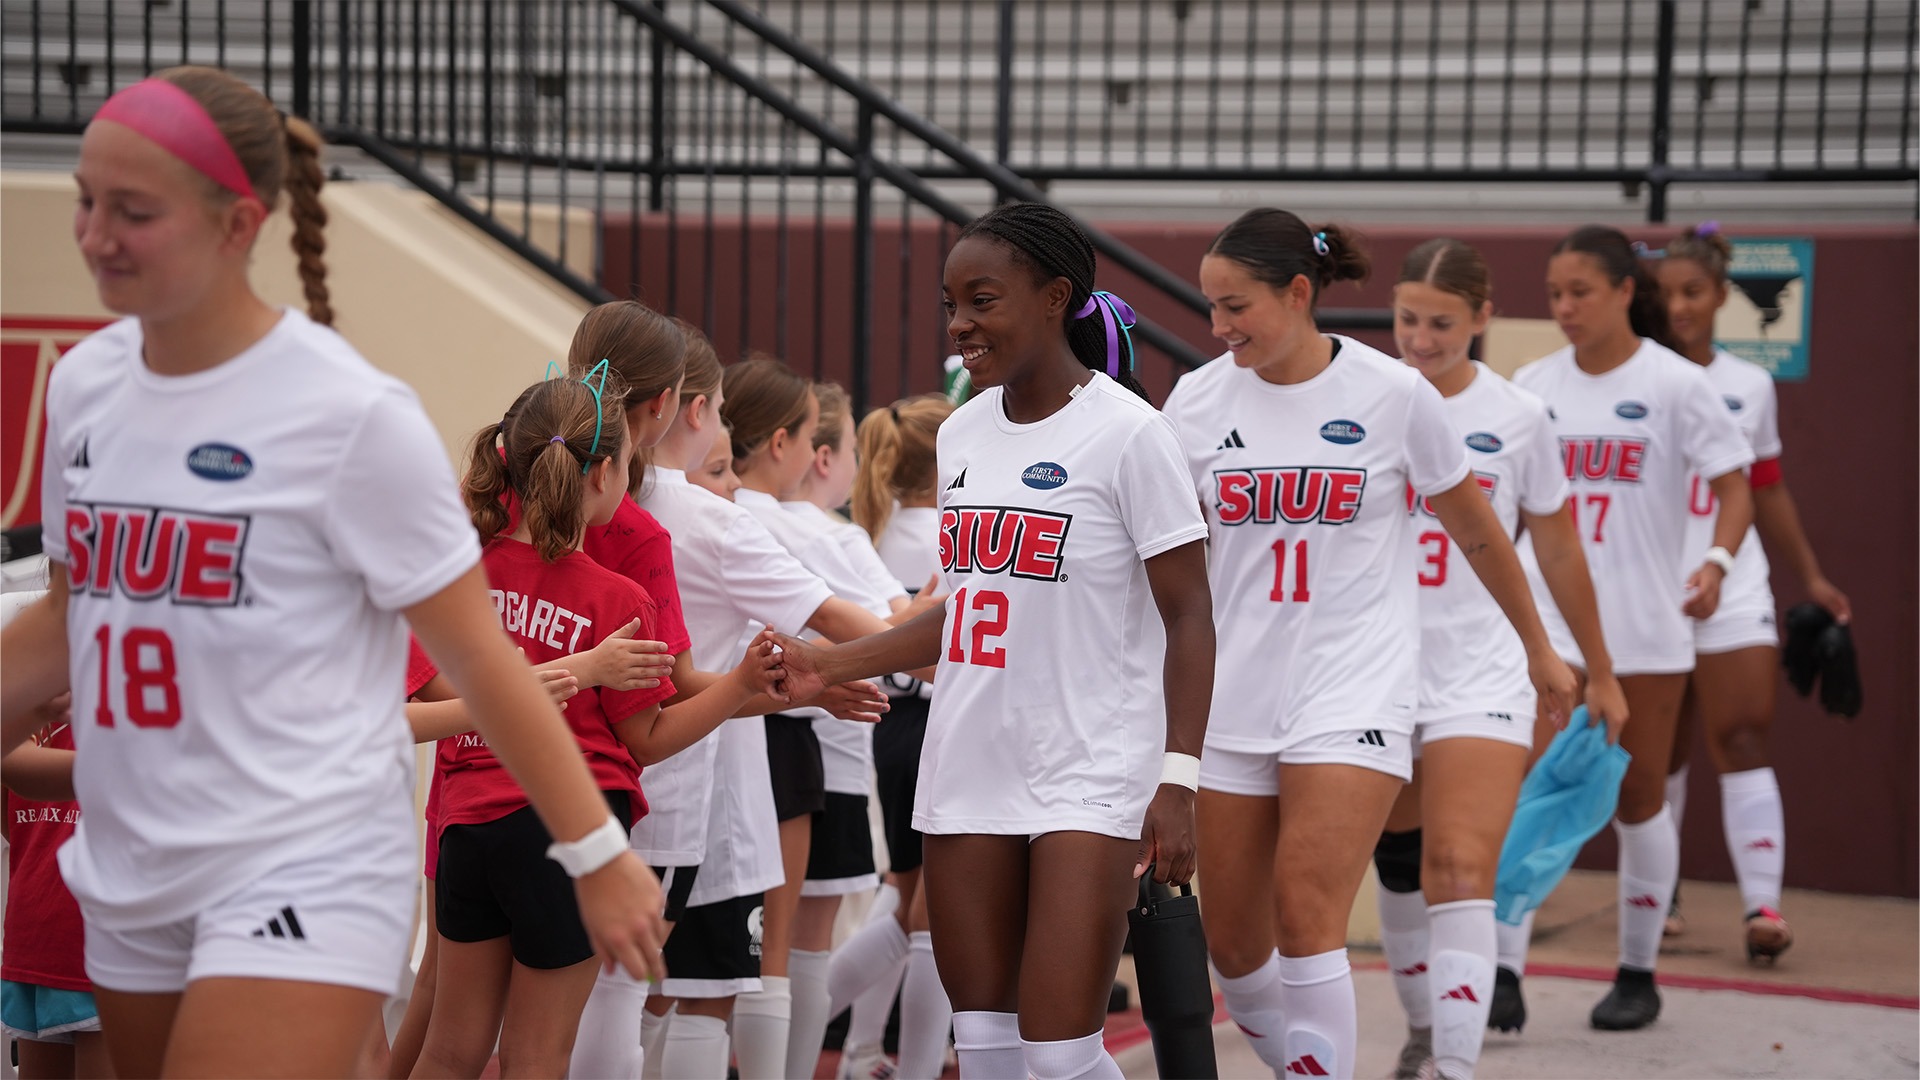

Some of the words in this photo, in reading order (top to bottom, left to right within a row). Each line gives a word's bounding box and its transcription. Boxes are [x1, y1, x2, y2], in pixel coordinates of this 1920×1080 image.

[1022, 472, 1067, 484] COMMUNITY
[1031, 466, 1054, 475] FIRST
[1560, 435, 1648, 484] IUE
[1213, 466, 1367, 525] SIUE
[66, 500, 250, 607] SIUE
[938, 505, 1073, 582] SIUE
[1269, 538, 1310, 602] 11
[948, 587, 1009, 669] 12
[95, 623, 182, 729] 18
